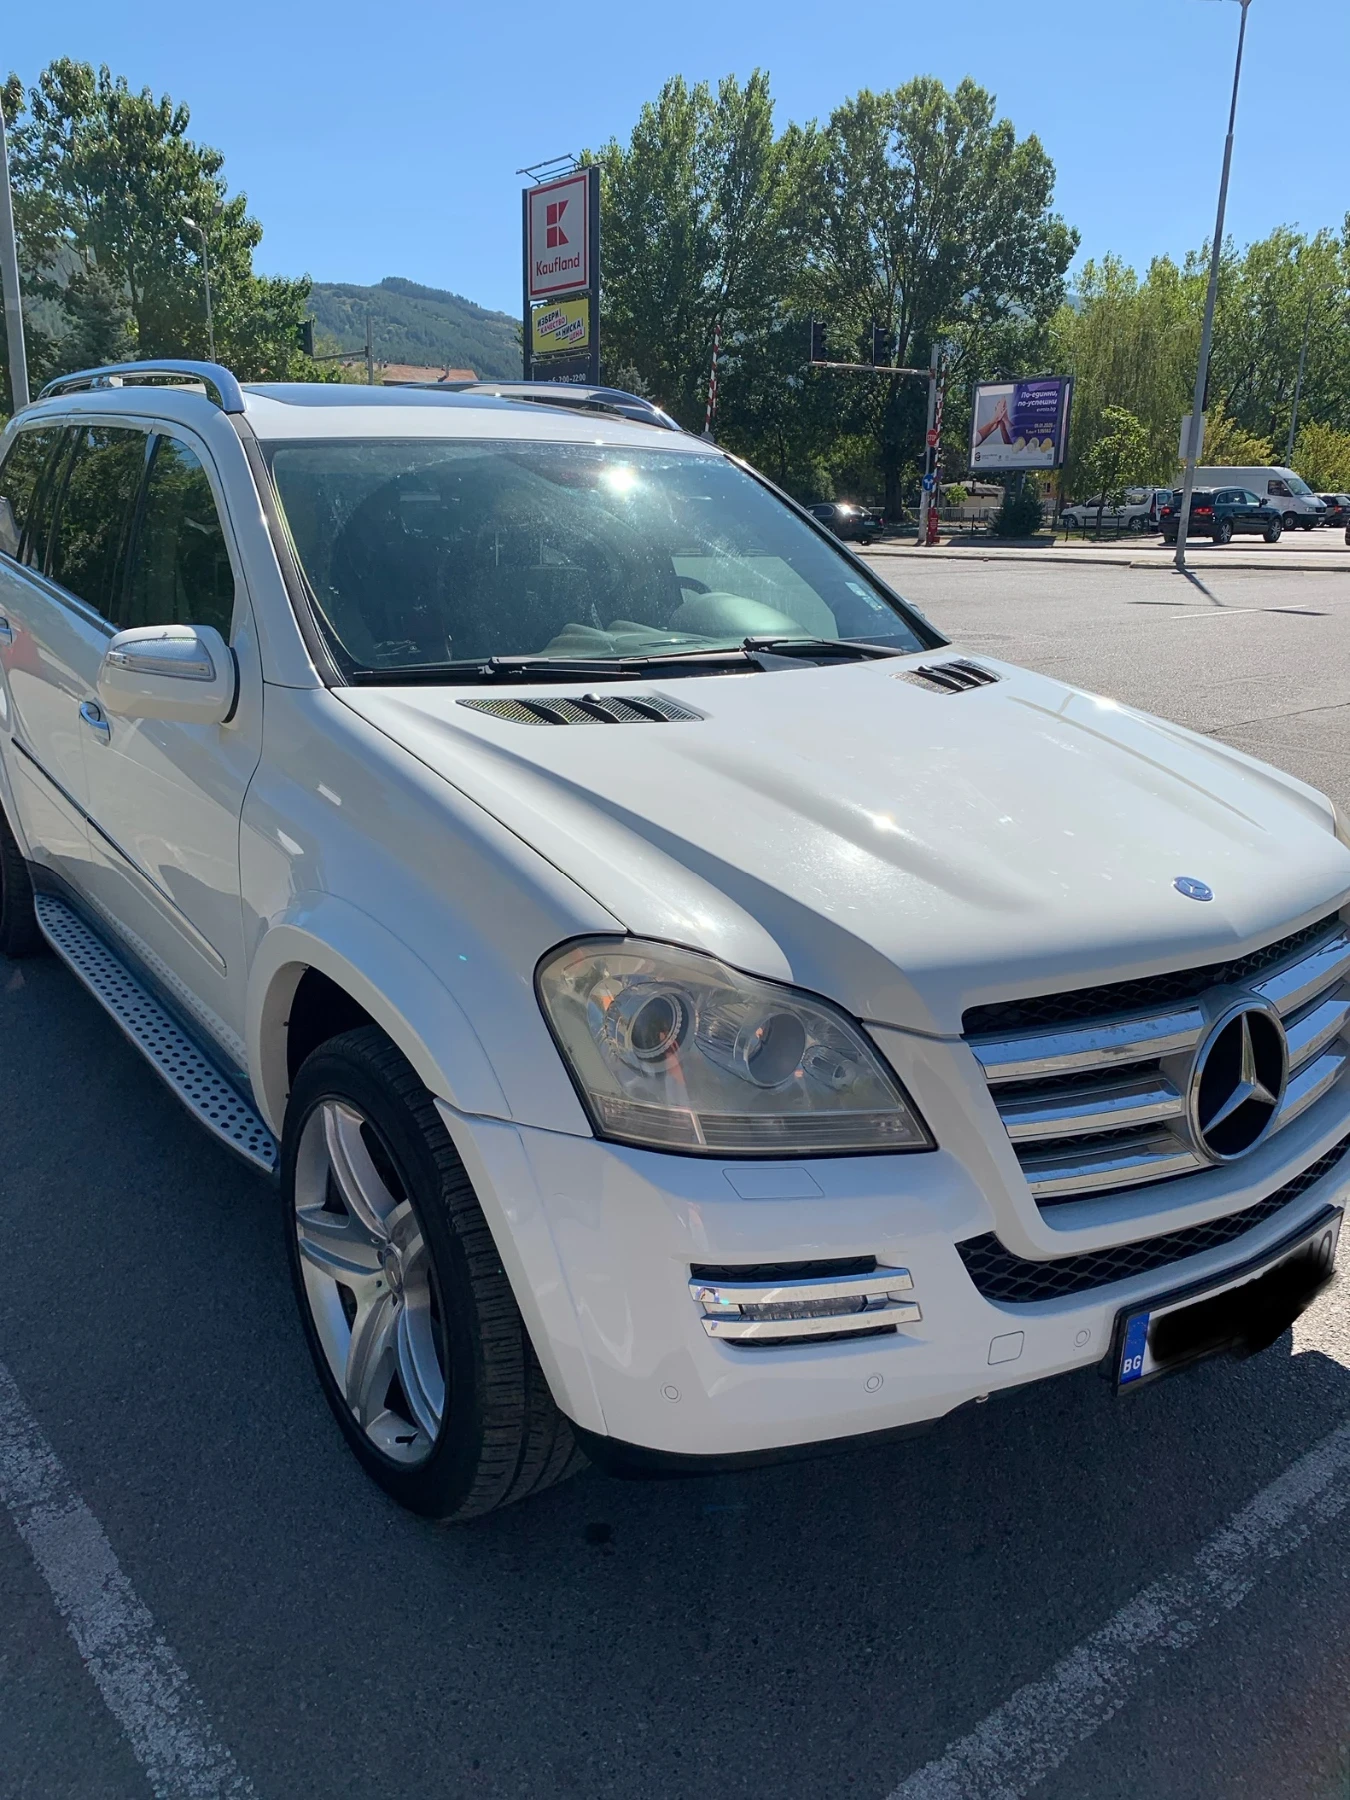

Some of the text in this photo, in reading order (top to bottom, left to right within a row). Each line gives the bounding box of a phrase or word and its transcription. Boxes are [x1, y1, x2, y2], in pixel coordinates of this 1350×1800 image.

[536, 252, 580, 276] Kaufland
[537, 310, 559, 327] ИЗБЕРИ
[540, 317, 566, 334] КАЧЕСТВО
[561, 320, 581, 336] НИСКА
[1018, 399, 1057, 407] по-успешни
[1123, 1355, 1142, 1373] BG
